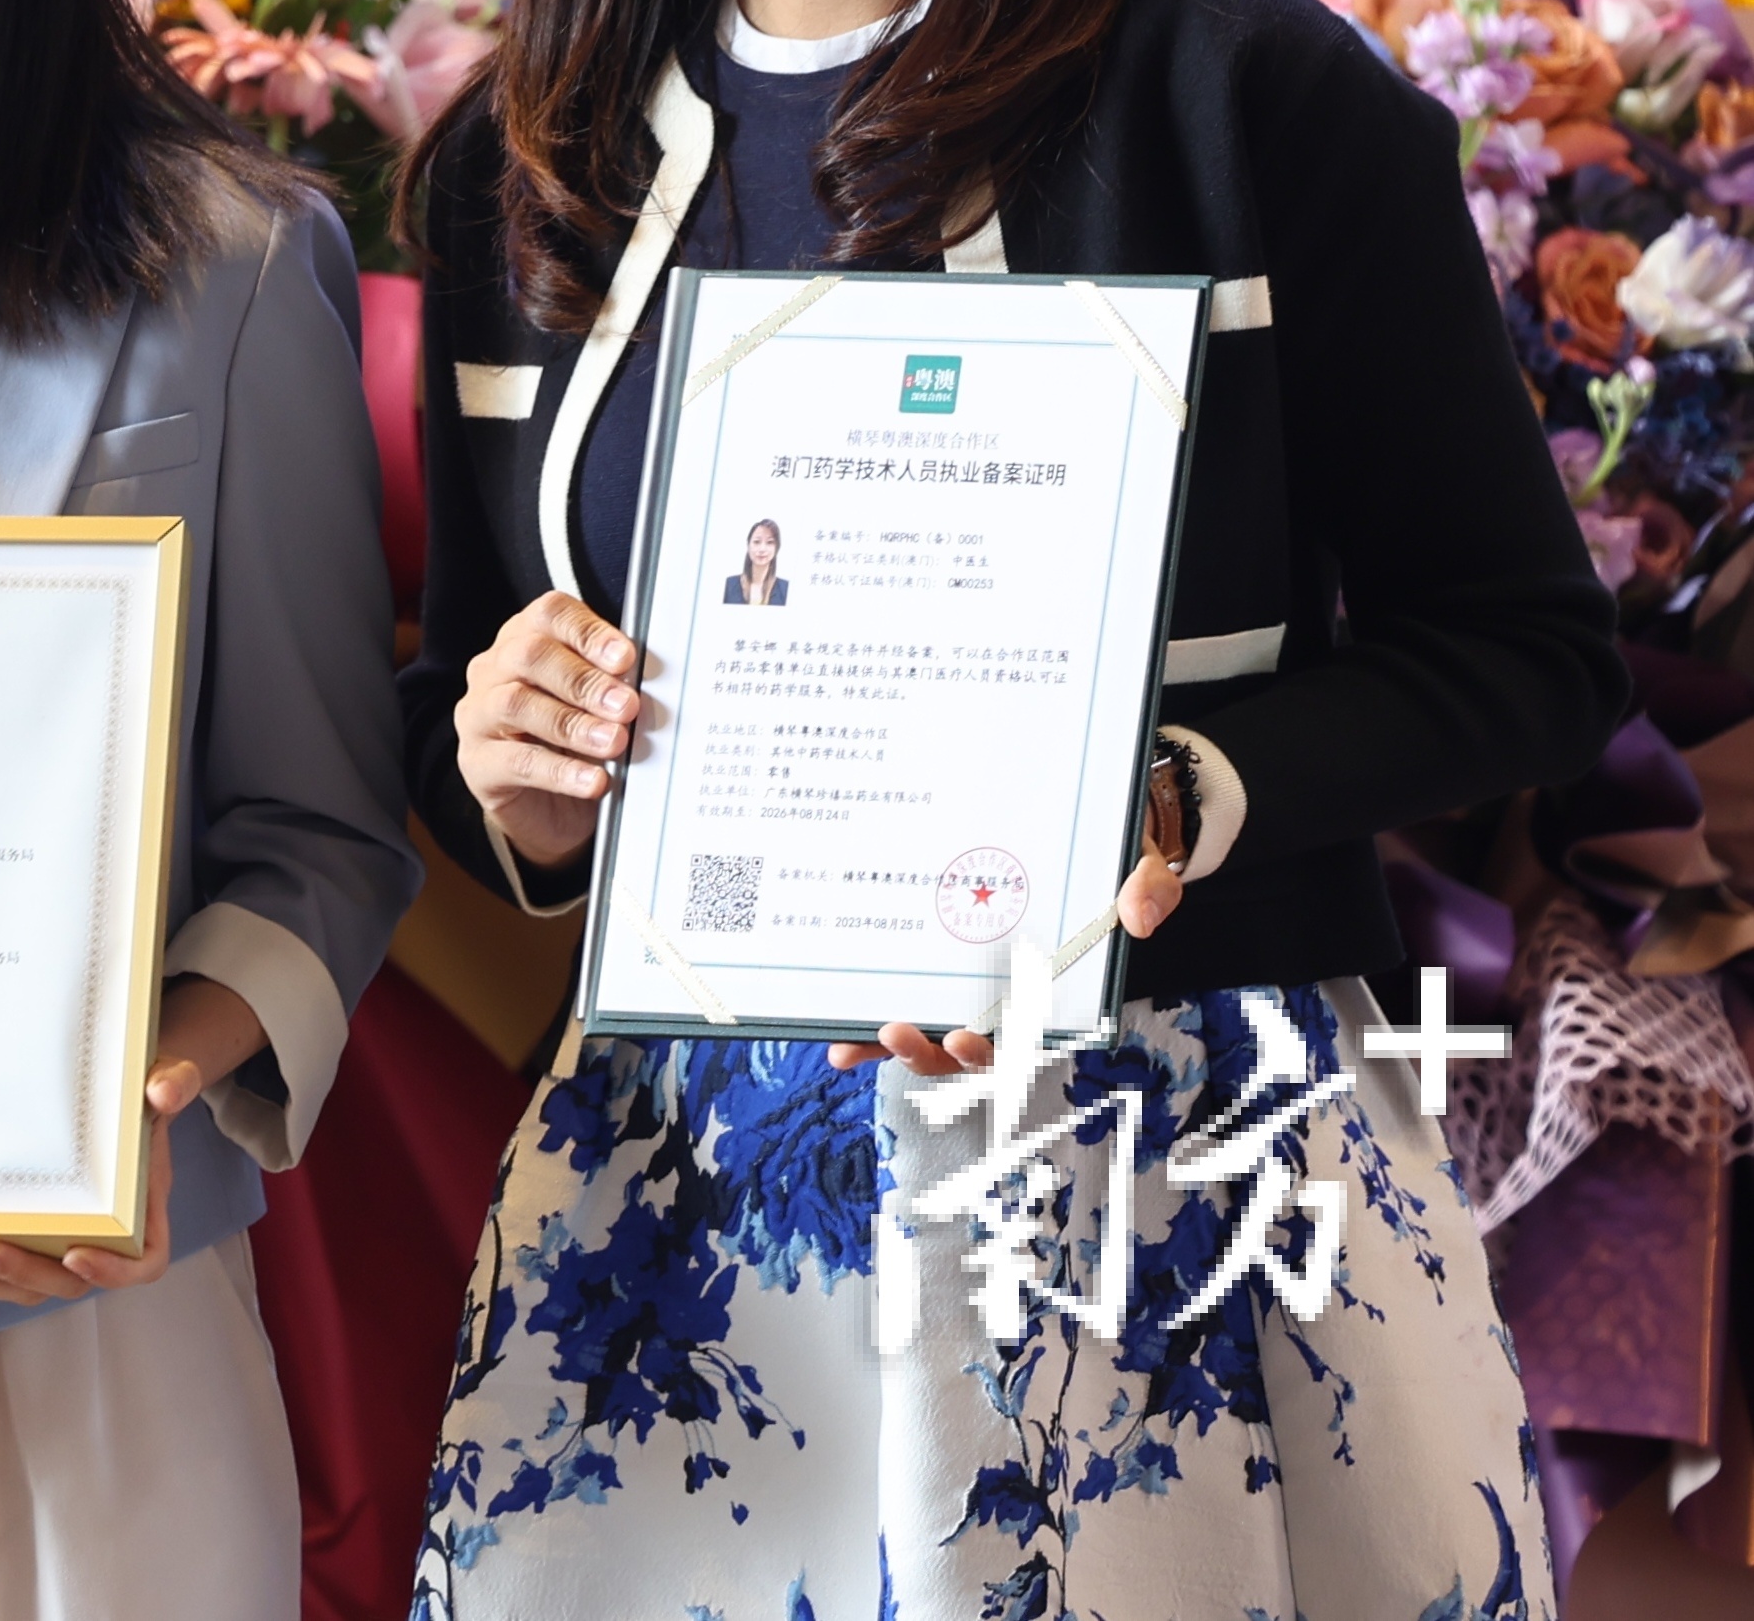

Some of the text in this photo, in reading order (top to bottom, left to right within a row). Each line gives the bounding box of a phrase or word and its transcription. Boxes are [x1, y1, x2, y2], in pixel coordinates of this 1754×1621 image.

[913, 366, 956, 392] 粤澳
[846, 428, 1000, 450] 横琴粤澳深度合作区
[770, 455, 1067, 487] 澳门药学技术人员执业备案证明
[952, 555, 989, 568] 中医生
[712, 680, 906, 701] 书相符的药学服务，特发此证。
[773, 724, 887, 740] 横琴粤澳深度合作区
[767, 765, 791, 779] 零售
[760, 806, 850, 821] 2026年08月24日
[835, 916, 925, 931] 2023年08月25日
